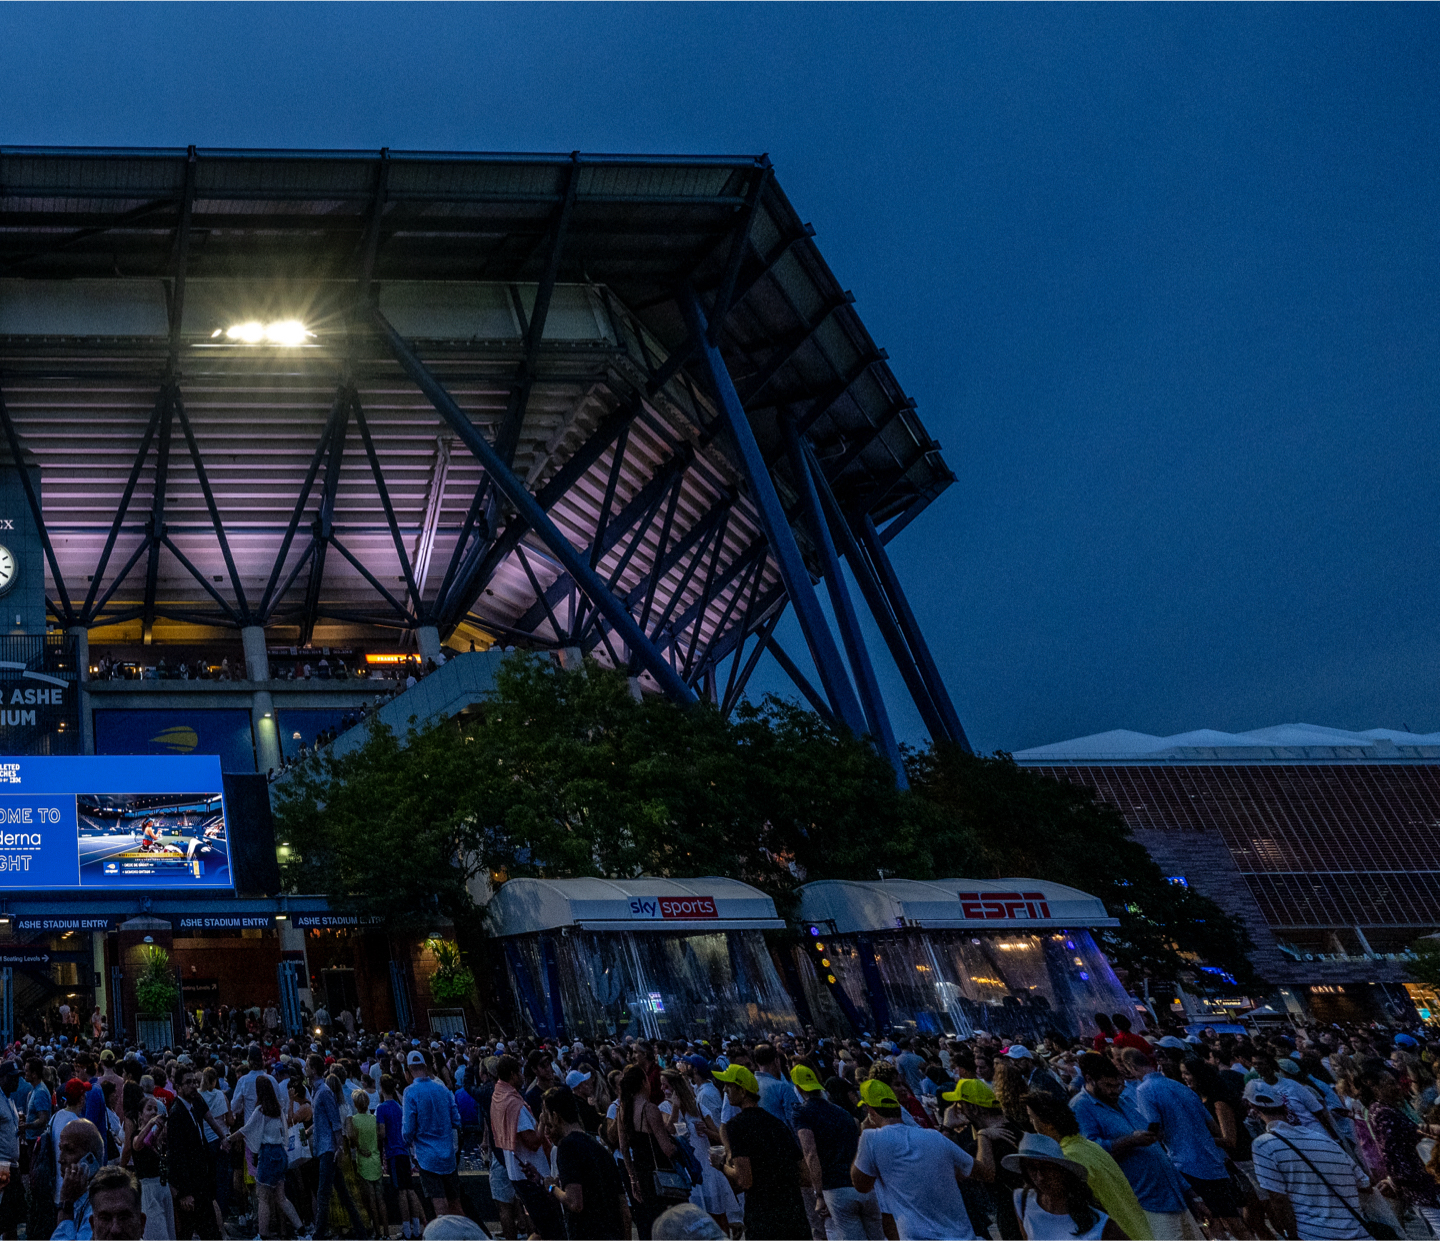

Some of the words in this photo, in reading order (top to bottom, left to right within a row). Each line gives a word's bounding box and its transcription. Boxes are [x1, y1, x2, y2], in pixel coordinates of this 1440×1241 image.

[10, 688, 63, 705] ASHE
[37, 808, 61, 824] TO
[630, 898, 657, 918] sky
[662, 899, 714, 917] sports
[959, 892, 1051, 919] ESPN
[18, 920, 41, 929] ASHE
[42, 920, 80, 929] STADIUM
[81, 919, 109, 928] ENTRY
[180, 918, 203, 927] ASHE
[204, 918, 241, 927] STADIUM
[242, 918, 269, 926] ENTRY
[298, 917, 321, 926] ASHE
[322, 916, 358, 925] STADIUM
[3, 955, 23, 964] Seating
[23, 955, 40, 963] Levels
